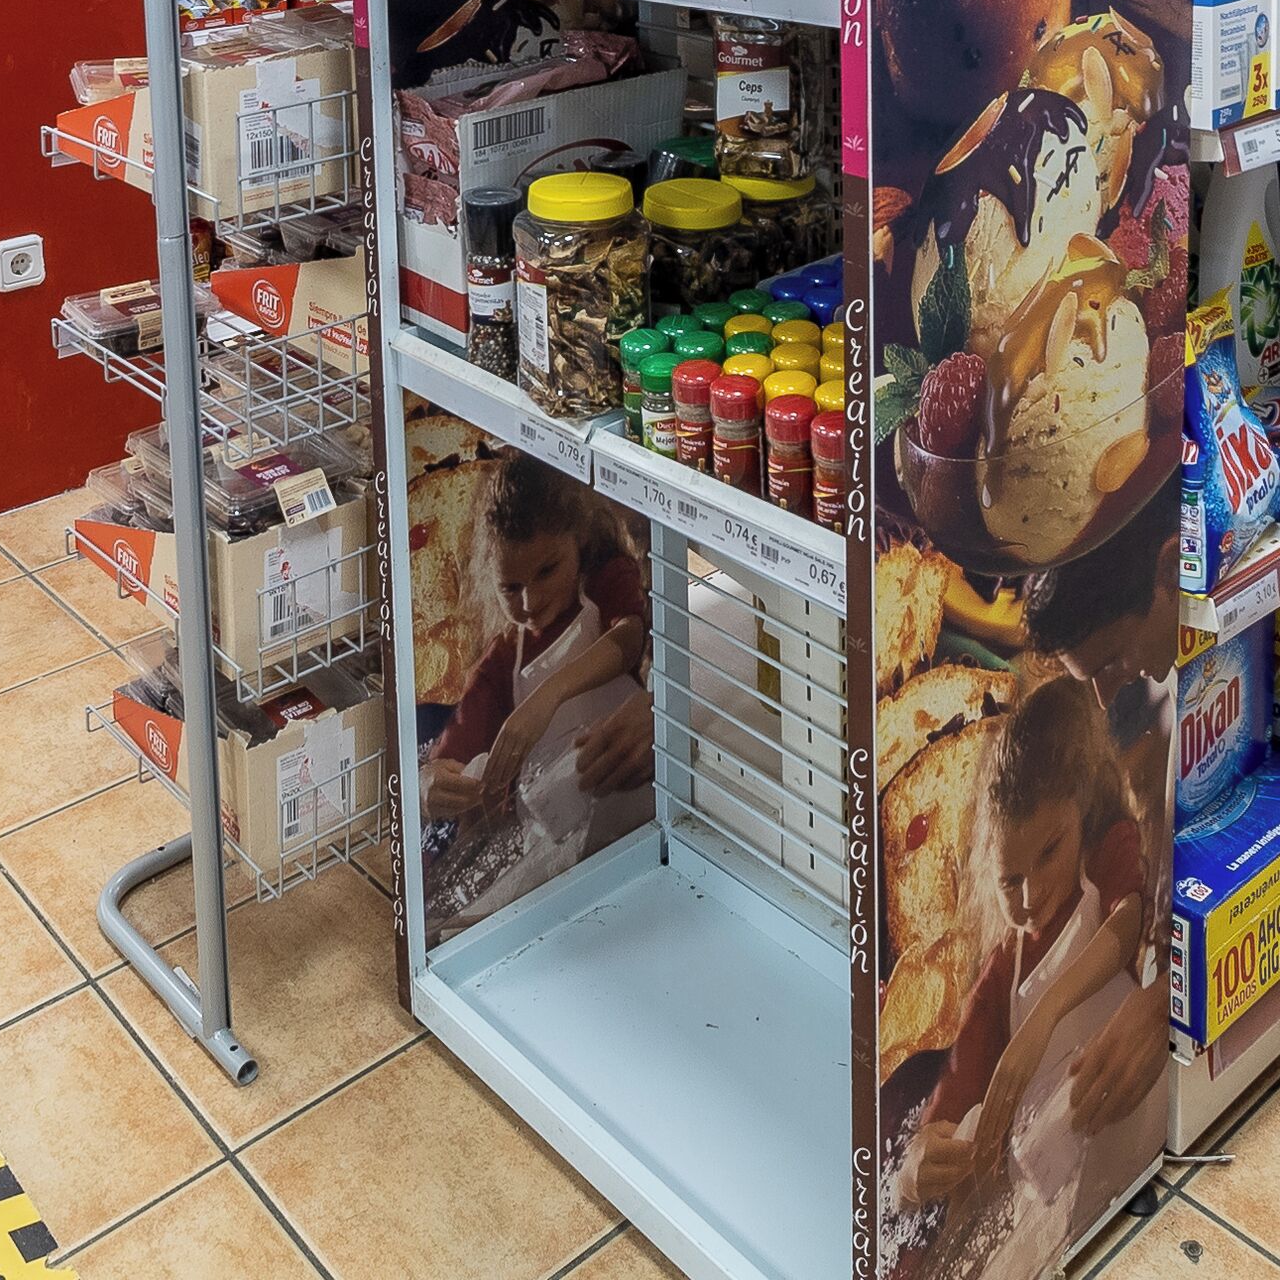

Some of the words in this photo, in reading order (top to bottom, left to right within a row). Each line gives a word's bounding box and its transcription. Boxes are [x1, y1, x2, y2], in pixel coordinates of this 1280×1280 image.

[718, 51, 763, 68] Gourmet
[738, 80, 763, 95] Ceps
[1253, 63, 1268, 93] 3x
[97, 126, 119, 148] FRIT
[1245, 252, 1268, 265] GRATIS
[257, 288, 280, 309] FRIT
[116, 547, 139, 573] FRIT
[1180, 675, 1240, 781] Dixan
[149, 730, 169, 755] FRIT
[1212, 931, 1256, 1009] 100
[1216, 979, 1258, 1026] LAVADOS
[853, 1147, 871, 1280] Creac
